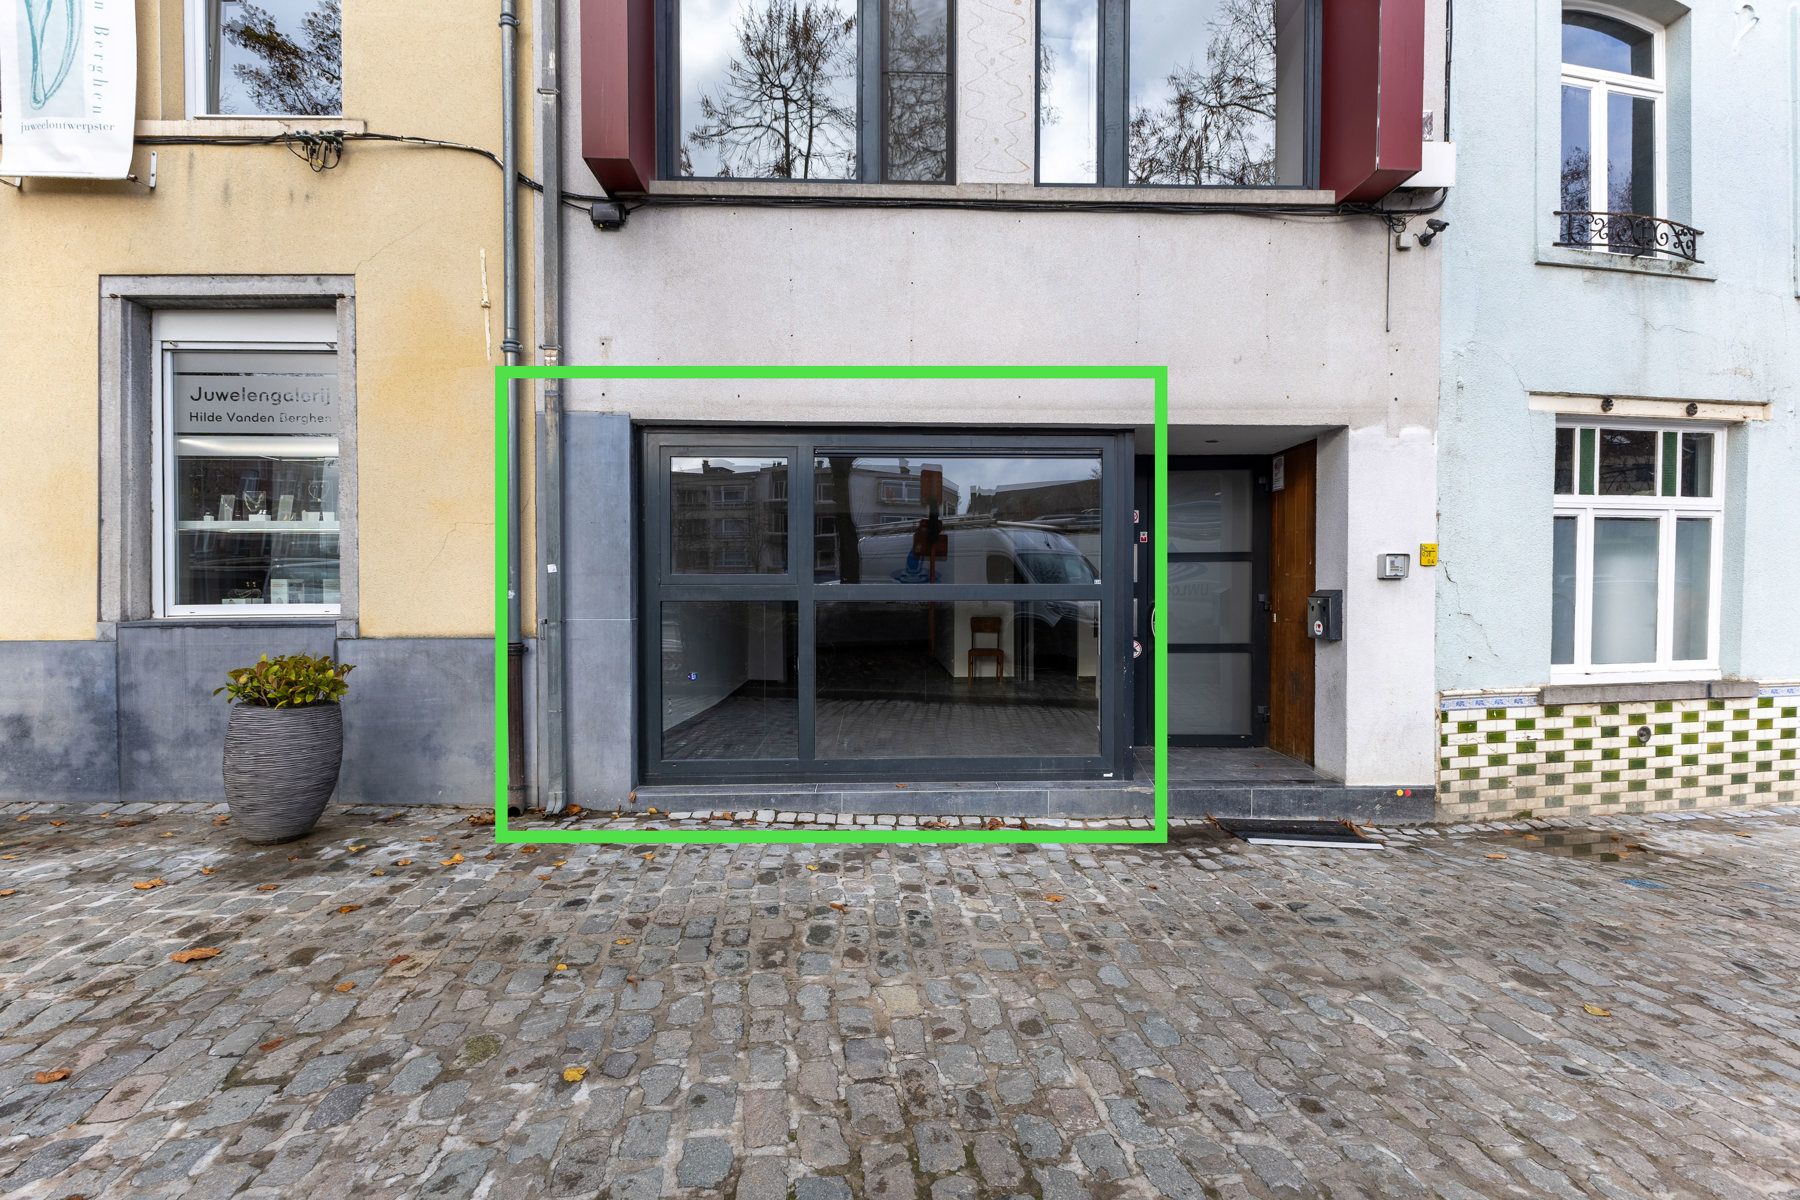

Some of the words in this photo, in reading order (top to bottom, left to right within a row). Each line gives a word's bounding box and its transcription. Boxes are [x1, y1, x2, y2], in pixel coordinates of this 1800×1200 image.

[90, 25, 110, 114] Berghen
[20, 119, 116, 134] juweelontwerpster
[189, 412, 223, 423] Hilde
[226, 412, 275, 423] Vanden
